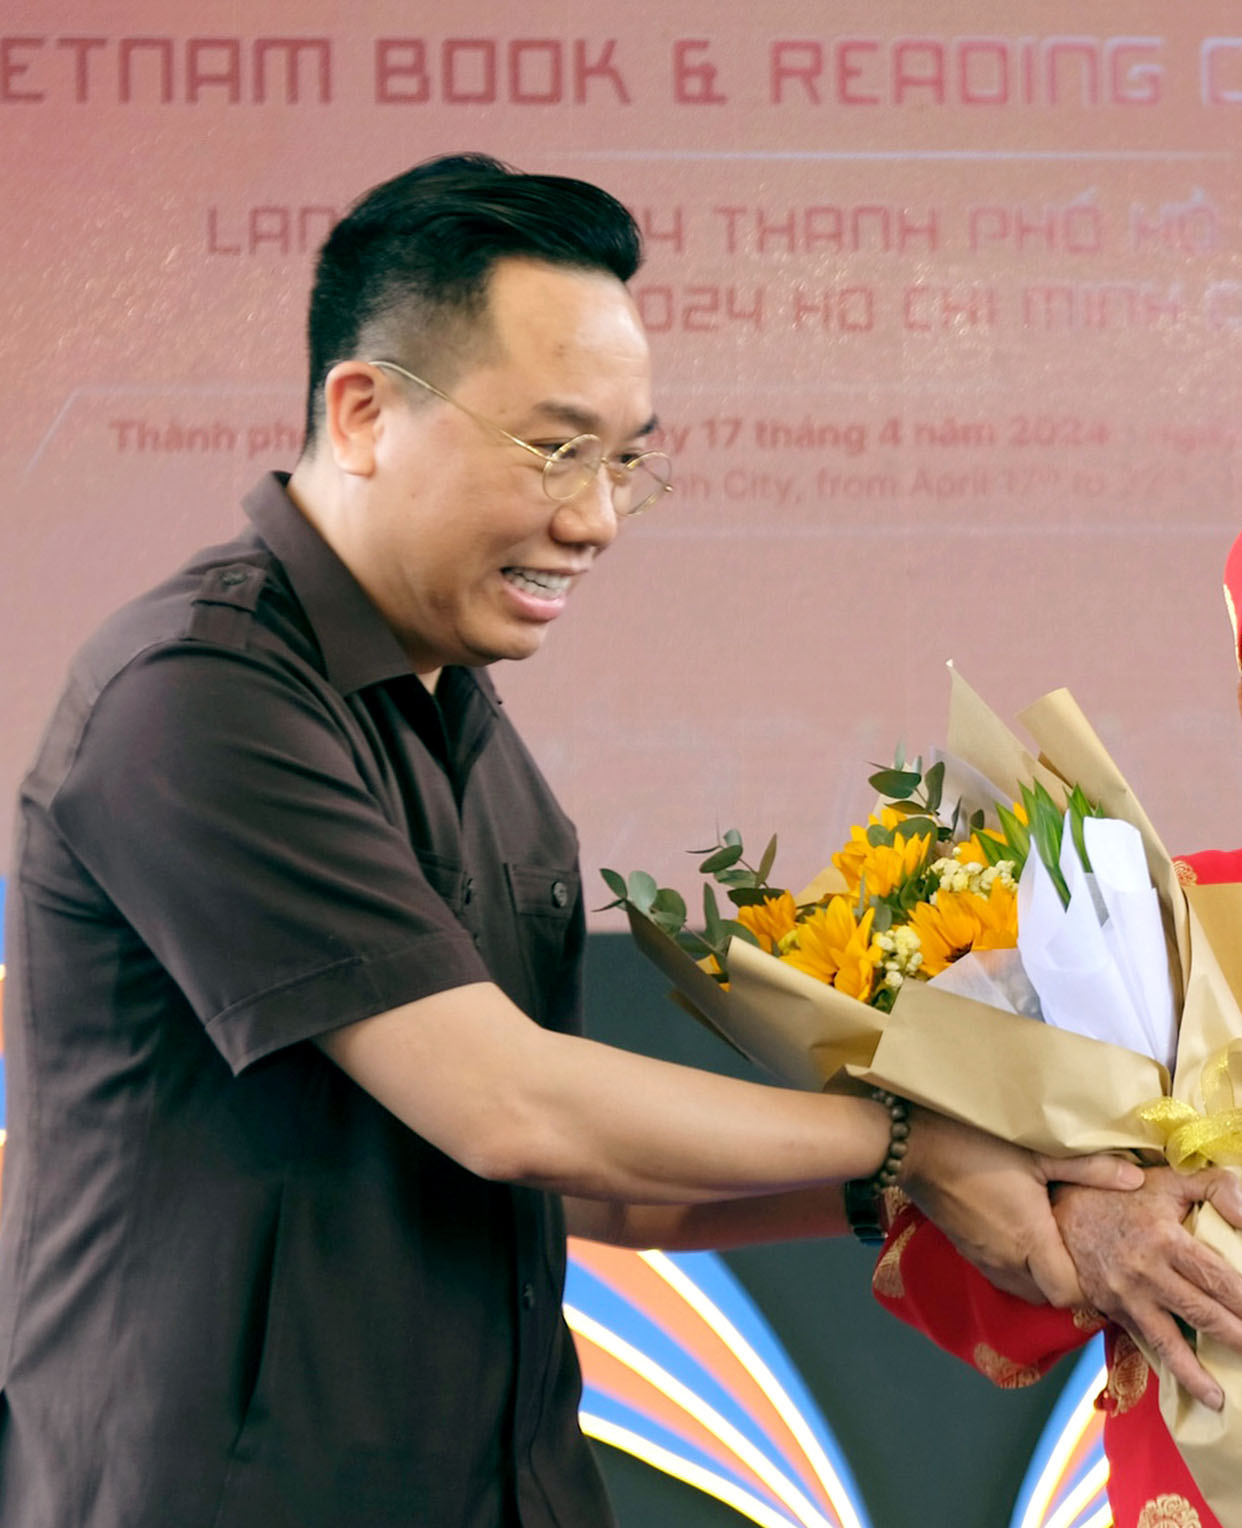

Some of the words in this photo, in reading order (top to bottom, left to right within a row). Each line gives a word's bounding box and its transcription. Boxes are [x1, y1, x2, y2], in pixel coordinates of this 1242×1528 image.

[374, 38, 632, 106] BOOK
[673, 39, 728, 105] &
[768, 37, 1165, 105] READING
[792, 285, 875, 332] HO
[903, 285, 997, 332] CHI
[1022, 282, 1183, 330] MINH
[700, 417, 743, 449] 17
[878, 416, 901, 446] 4
[1007, 415, 1113, 447] 2024
[816, 466, 897, 498] from
[912, 465, 988, 502] April
